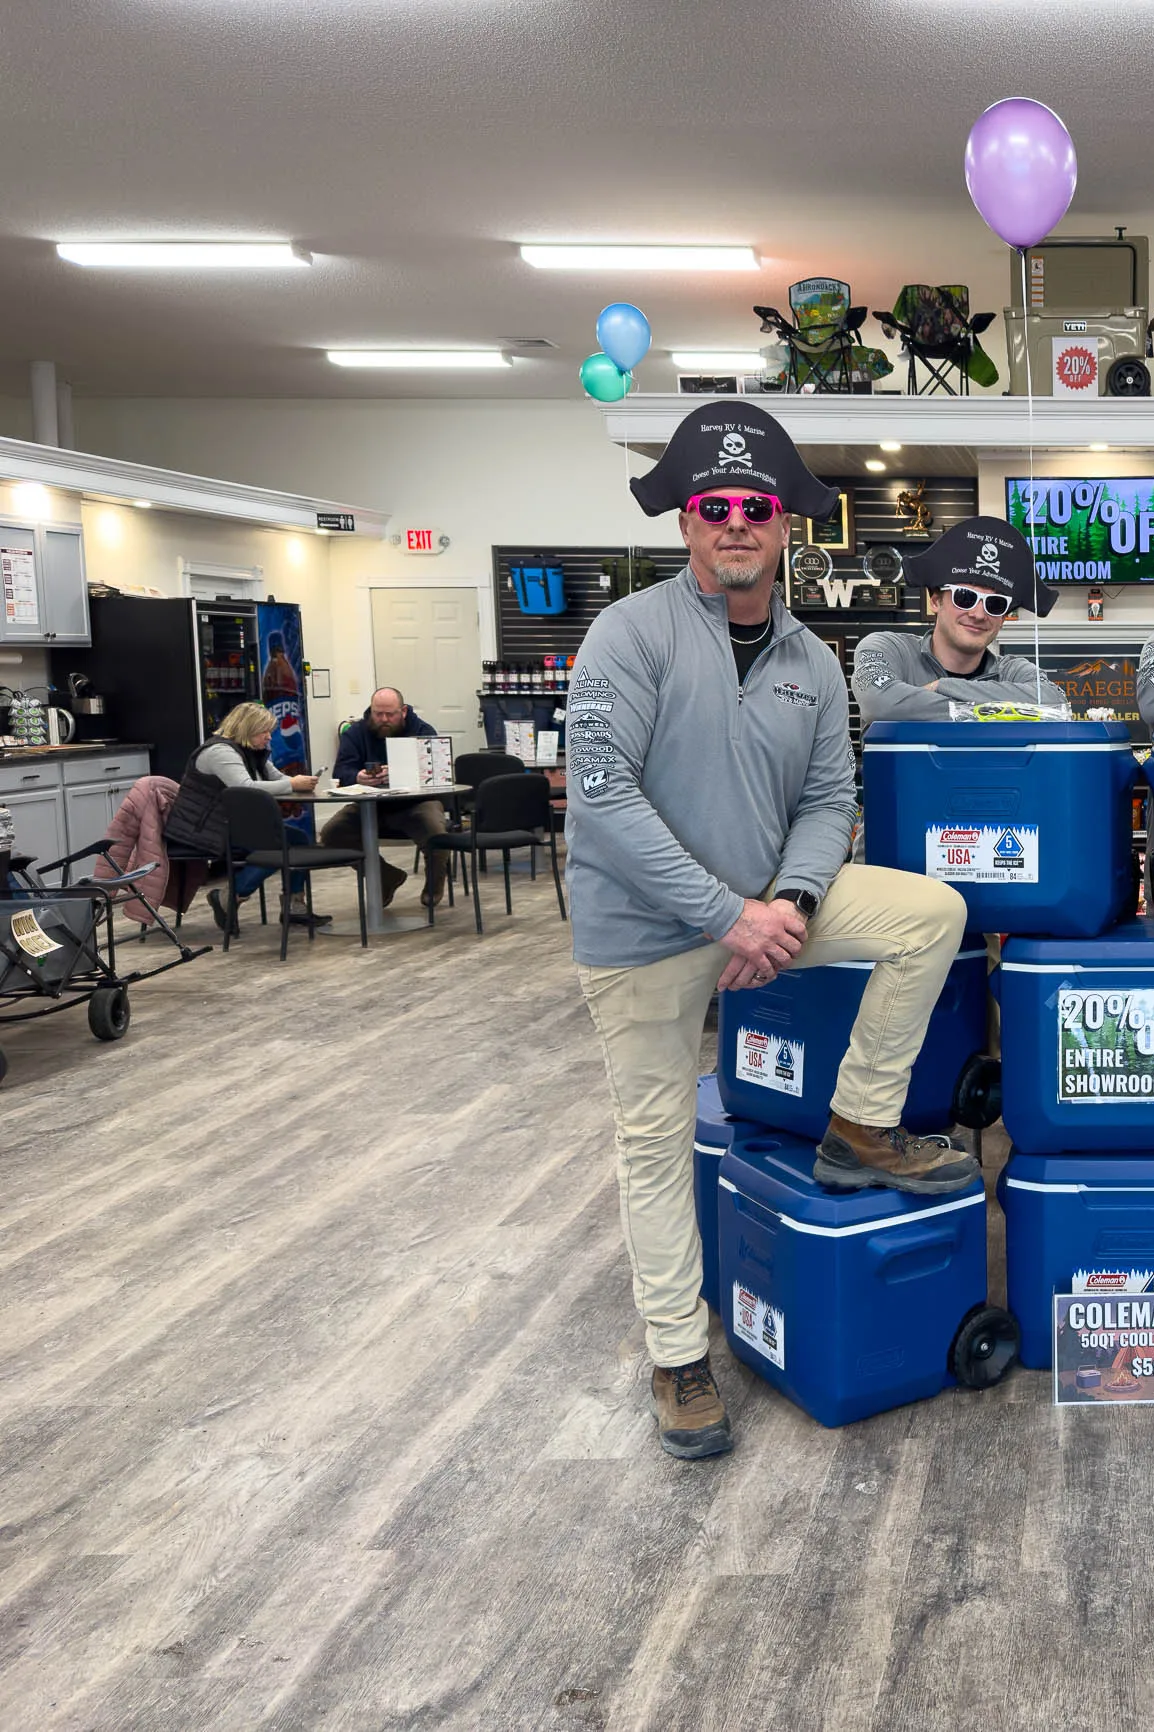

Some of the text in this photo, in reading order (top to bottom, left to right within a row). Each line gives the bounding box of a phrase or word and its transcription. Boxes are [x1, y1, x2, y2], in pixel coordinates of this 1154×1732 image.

[1065, 323, 1086, 331] YETI
[1064, 356, 1091, 375] 20%
[701, 424, 723, 432] Harvey
[724, 423, 735, 431] RV
[744, 425, 766, 436] Marine
[711, 466, 727, 475] Your
[1022, 482, 1120, 525] 20%
[407, 530, 432, 550] EXIT
[1026, 536, 1068, 555] TIRE
[1036, 561, 1112, 580] OWROOM
[575, 680, 609, 688] ALINER
[1054, 681, 1136, 697] TRAEGE
[570, 756, 616, 769] DYNAMAX
[582, 769, 607, 791] KZ
[943, 831, 972, 841] Coleman
[1005, 835, 1013, 849] 5
[947, 848, 971, 865] USA
[1063, 993, 1145, 1030] 20%
[748, 1051, 763, 1068] USA
[783, 1046, 788, 1059] 5
[1065, 1048, 1125, 1068] ENTIRE
[1089, 1275, 1120, 1285] Coleman
[1081, 1333, 1116, 1350] 50QT
